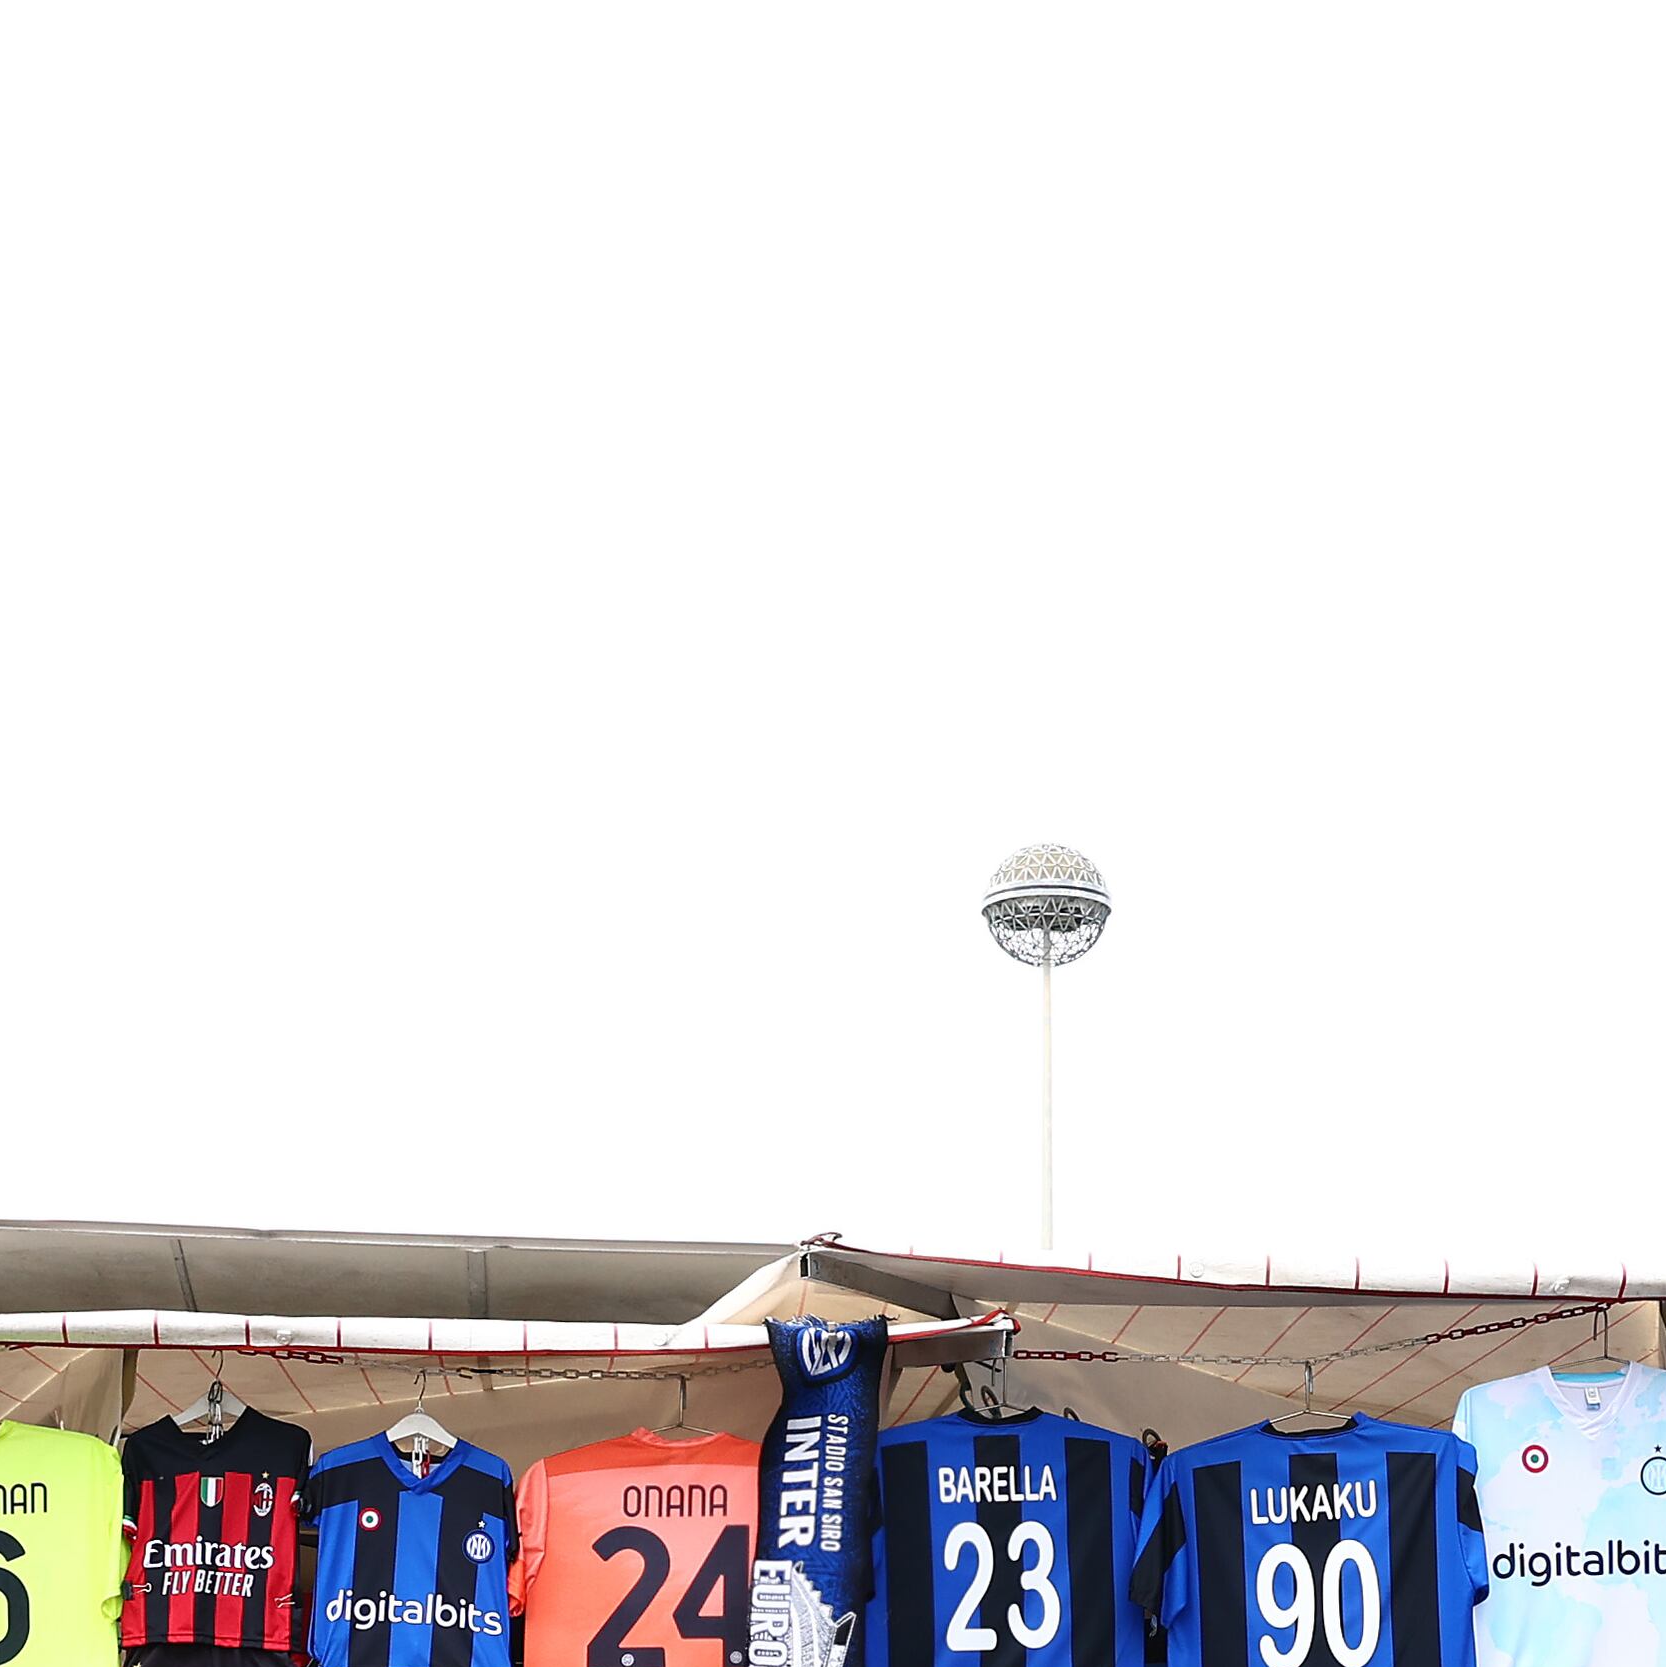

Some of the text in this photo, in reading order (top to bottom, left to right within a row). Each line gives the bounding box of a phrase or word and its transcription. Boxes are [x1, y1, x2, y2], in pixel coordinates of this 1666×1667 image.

[623, 1484, 727, 1518] ONANA
[777, 1416, 822, 1549] INTER
[821, 1414, 849, 1552] STADIO SAN SIRO
[938, 1464, 1057, 1503] BARELLA
[1250, 1484, 1378, 1525] LUKAKU
[143, 1535, 273, 1573] Emirates
[162, 1569, 253, 1598] FLY BETTER
[943, 1521, 1061, 1652] 23
[325, 1589, 502, 1634] digitalbits
